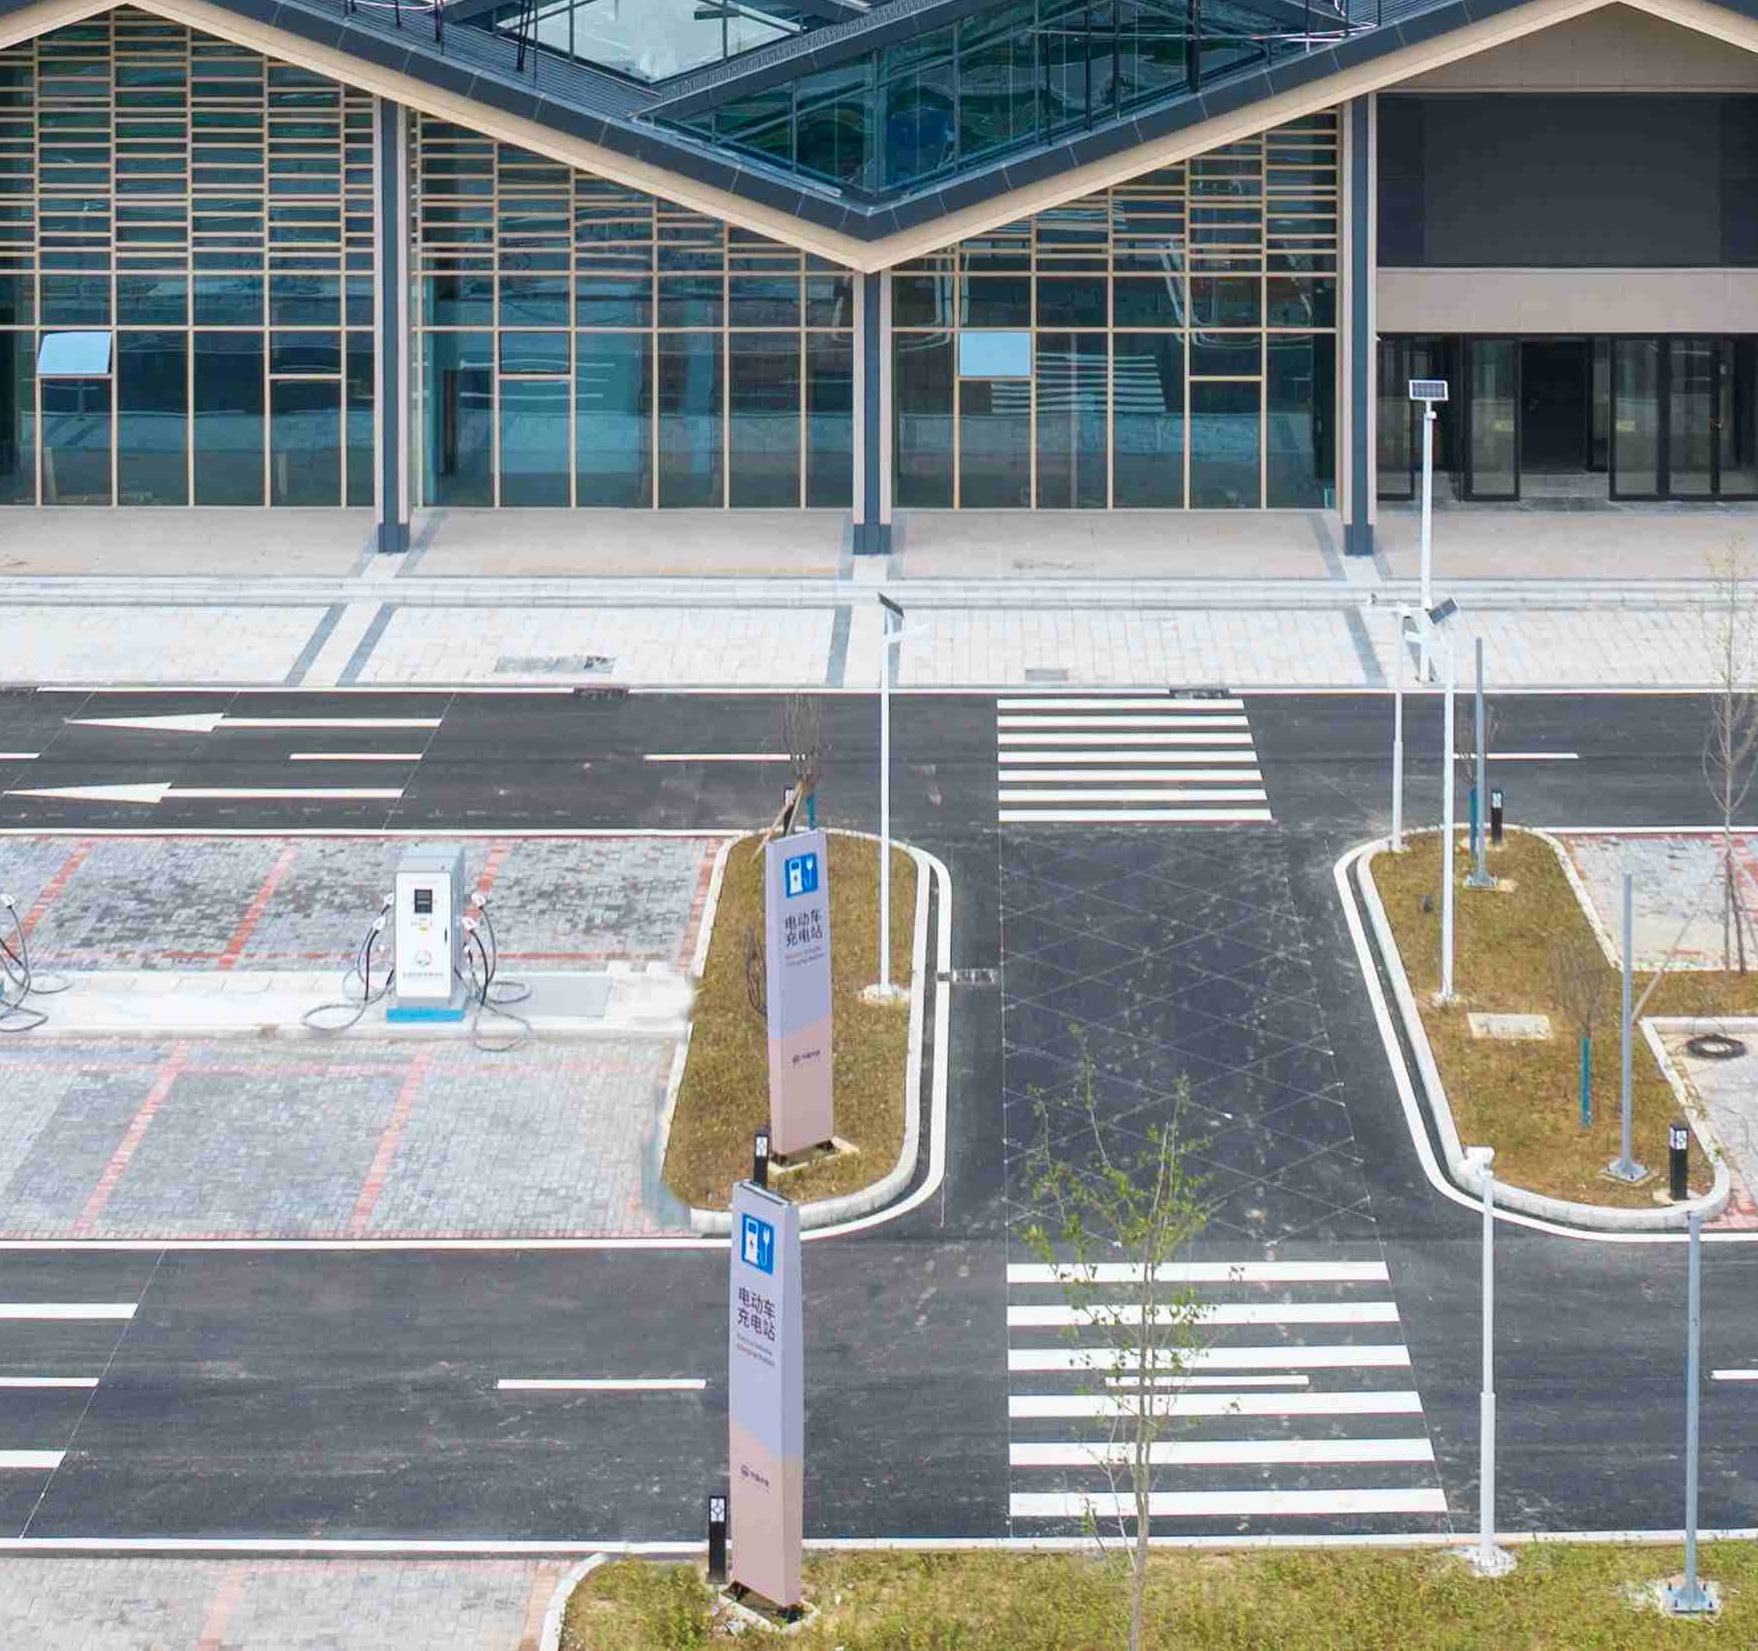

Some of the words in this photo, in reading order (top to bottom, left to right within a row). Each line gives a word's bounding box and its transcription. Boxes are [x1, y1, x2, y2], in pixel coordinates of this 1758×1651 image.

[785, 909, 821, 931] 电动车
[786, 926, 823, 948] 充电站
[738, 1285, 776, 1319] 电动车
[738, 1307, 776, 1343] 充电站
